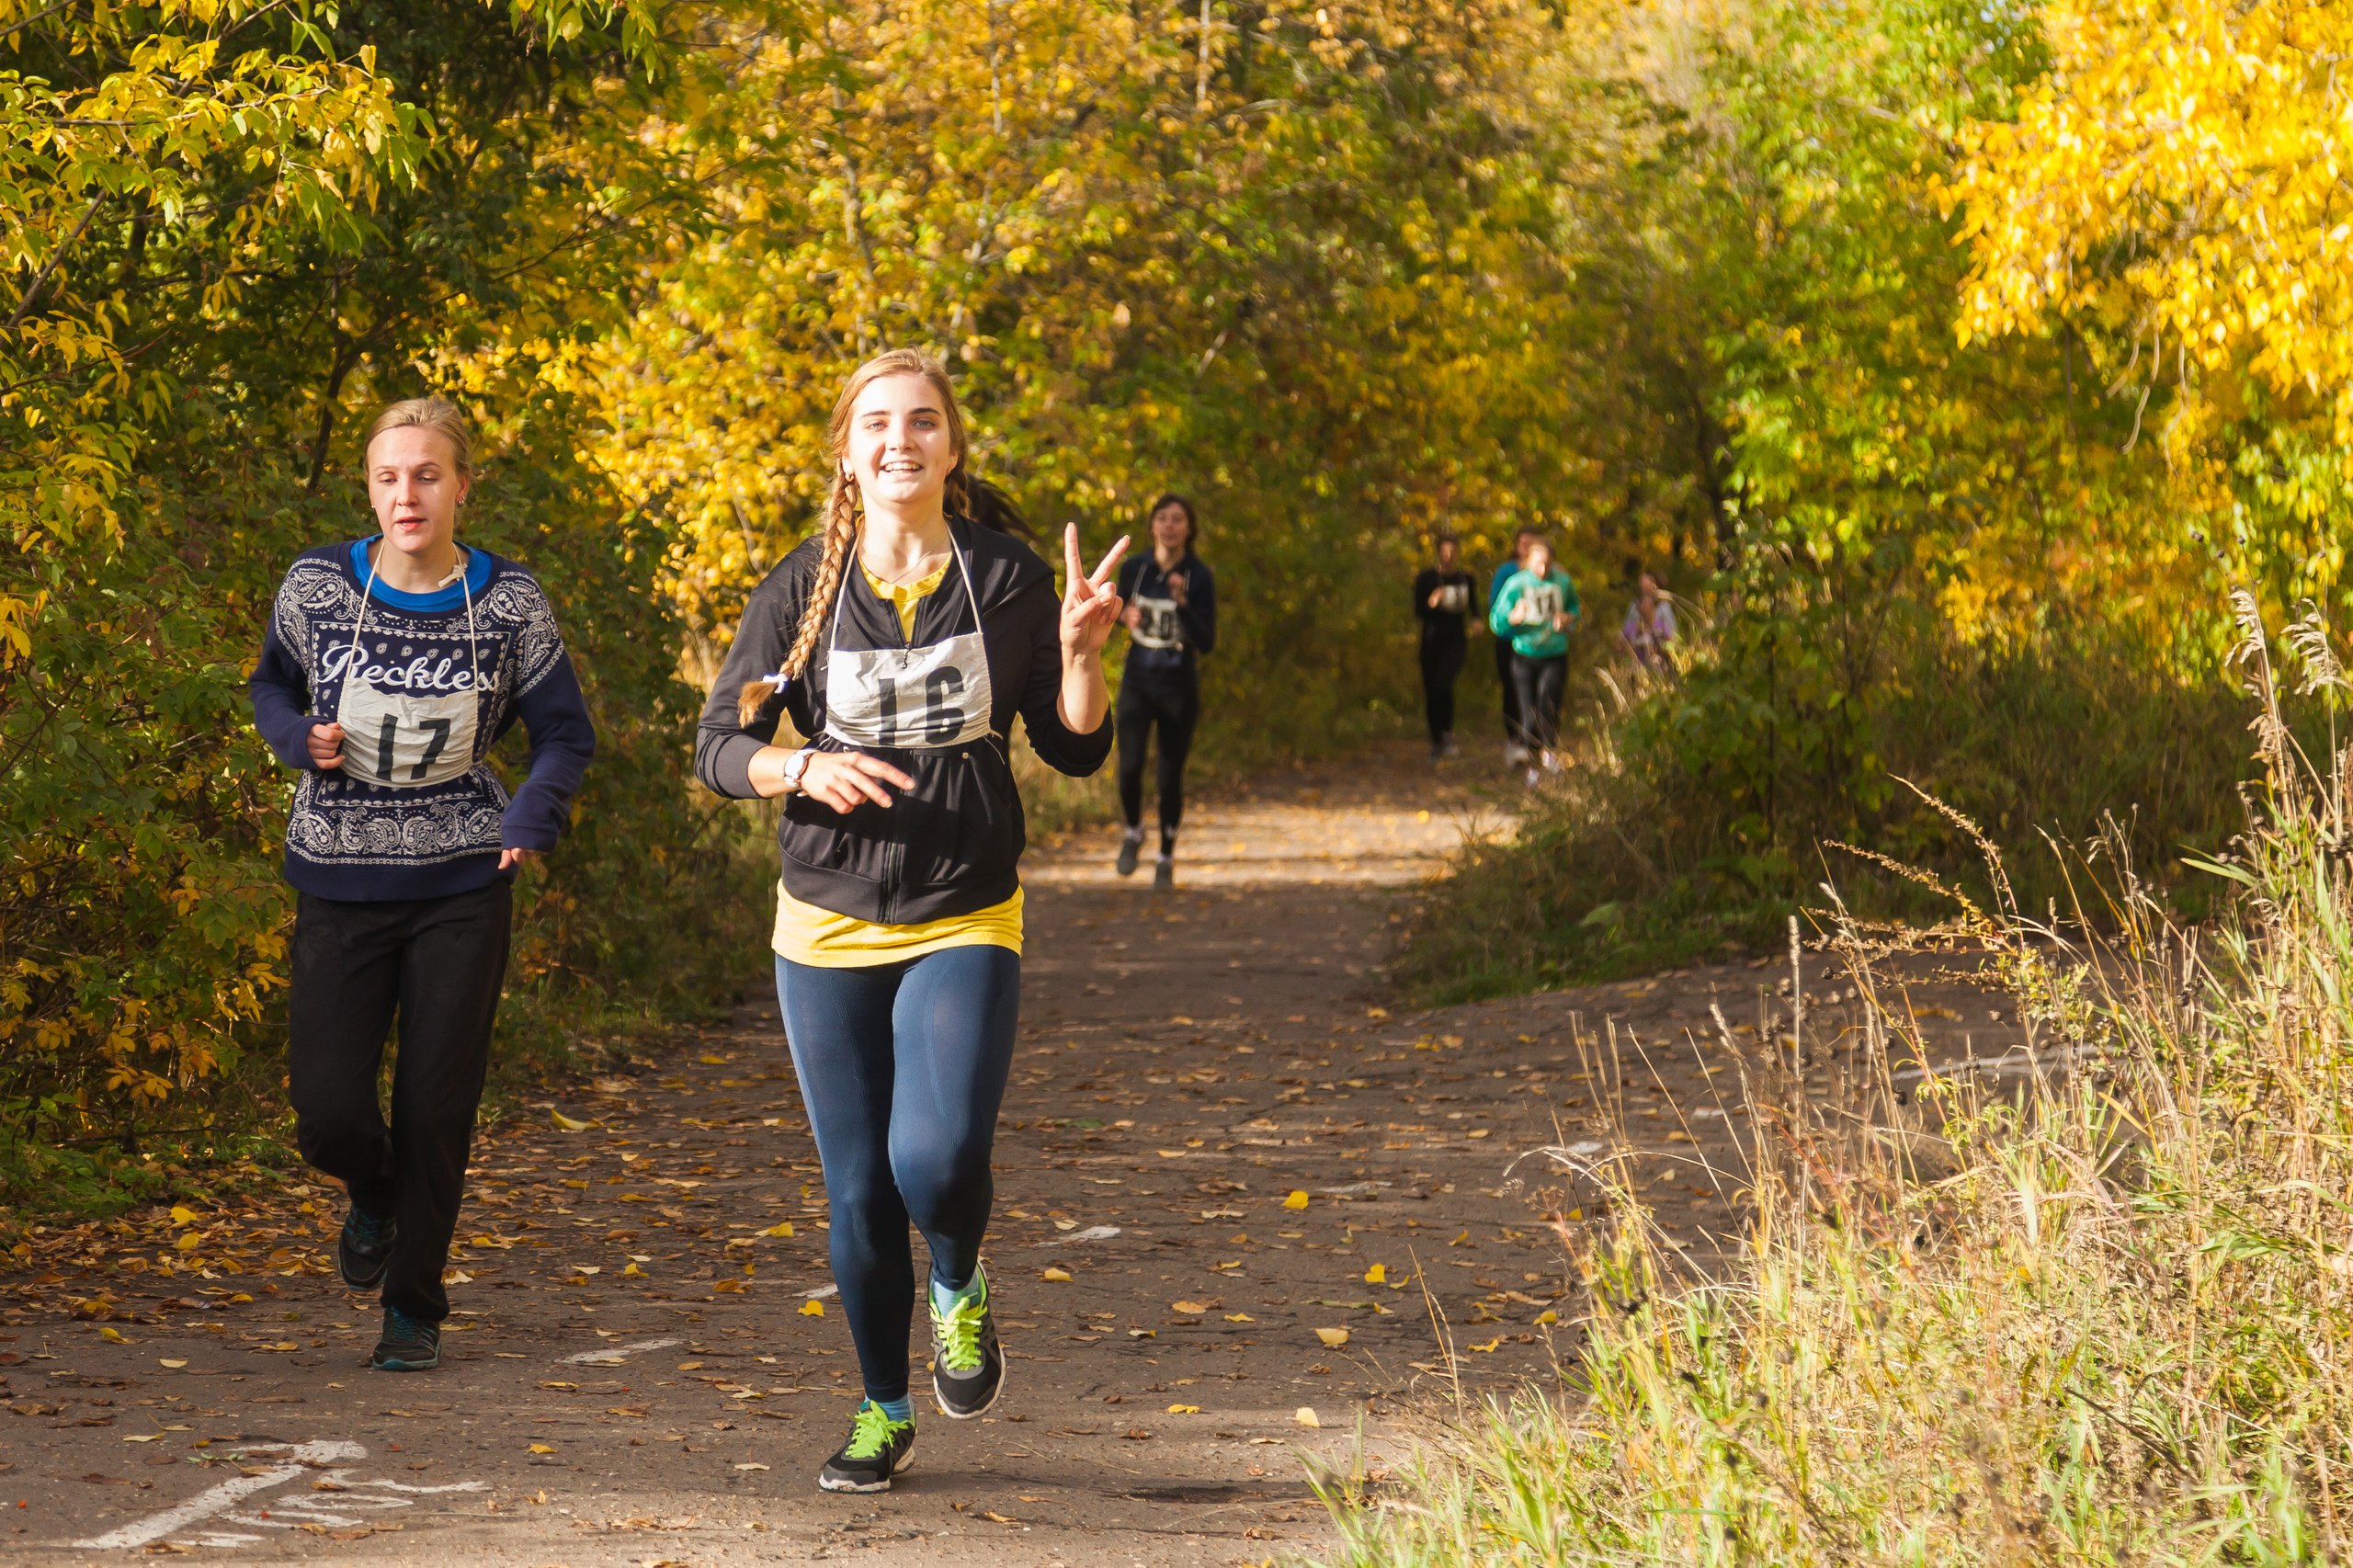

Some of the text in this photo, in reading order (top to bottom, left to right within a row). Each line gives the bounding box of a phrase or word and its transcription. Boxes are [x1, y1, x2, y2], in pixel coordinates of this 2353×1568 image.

[317, 644, 500, 691] Reckless
[878, 665, 966, 746] 16
[376, 712, 450, 781] 17
